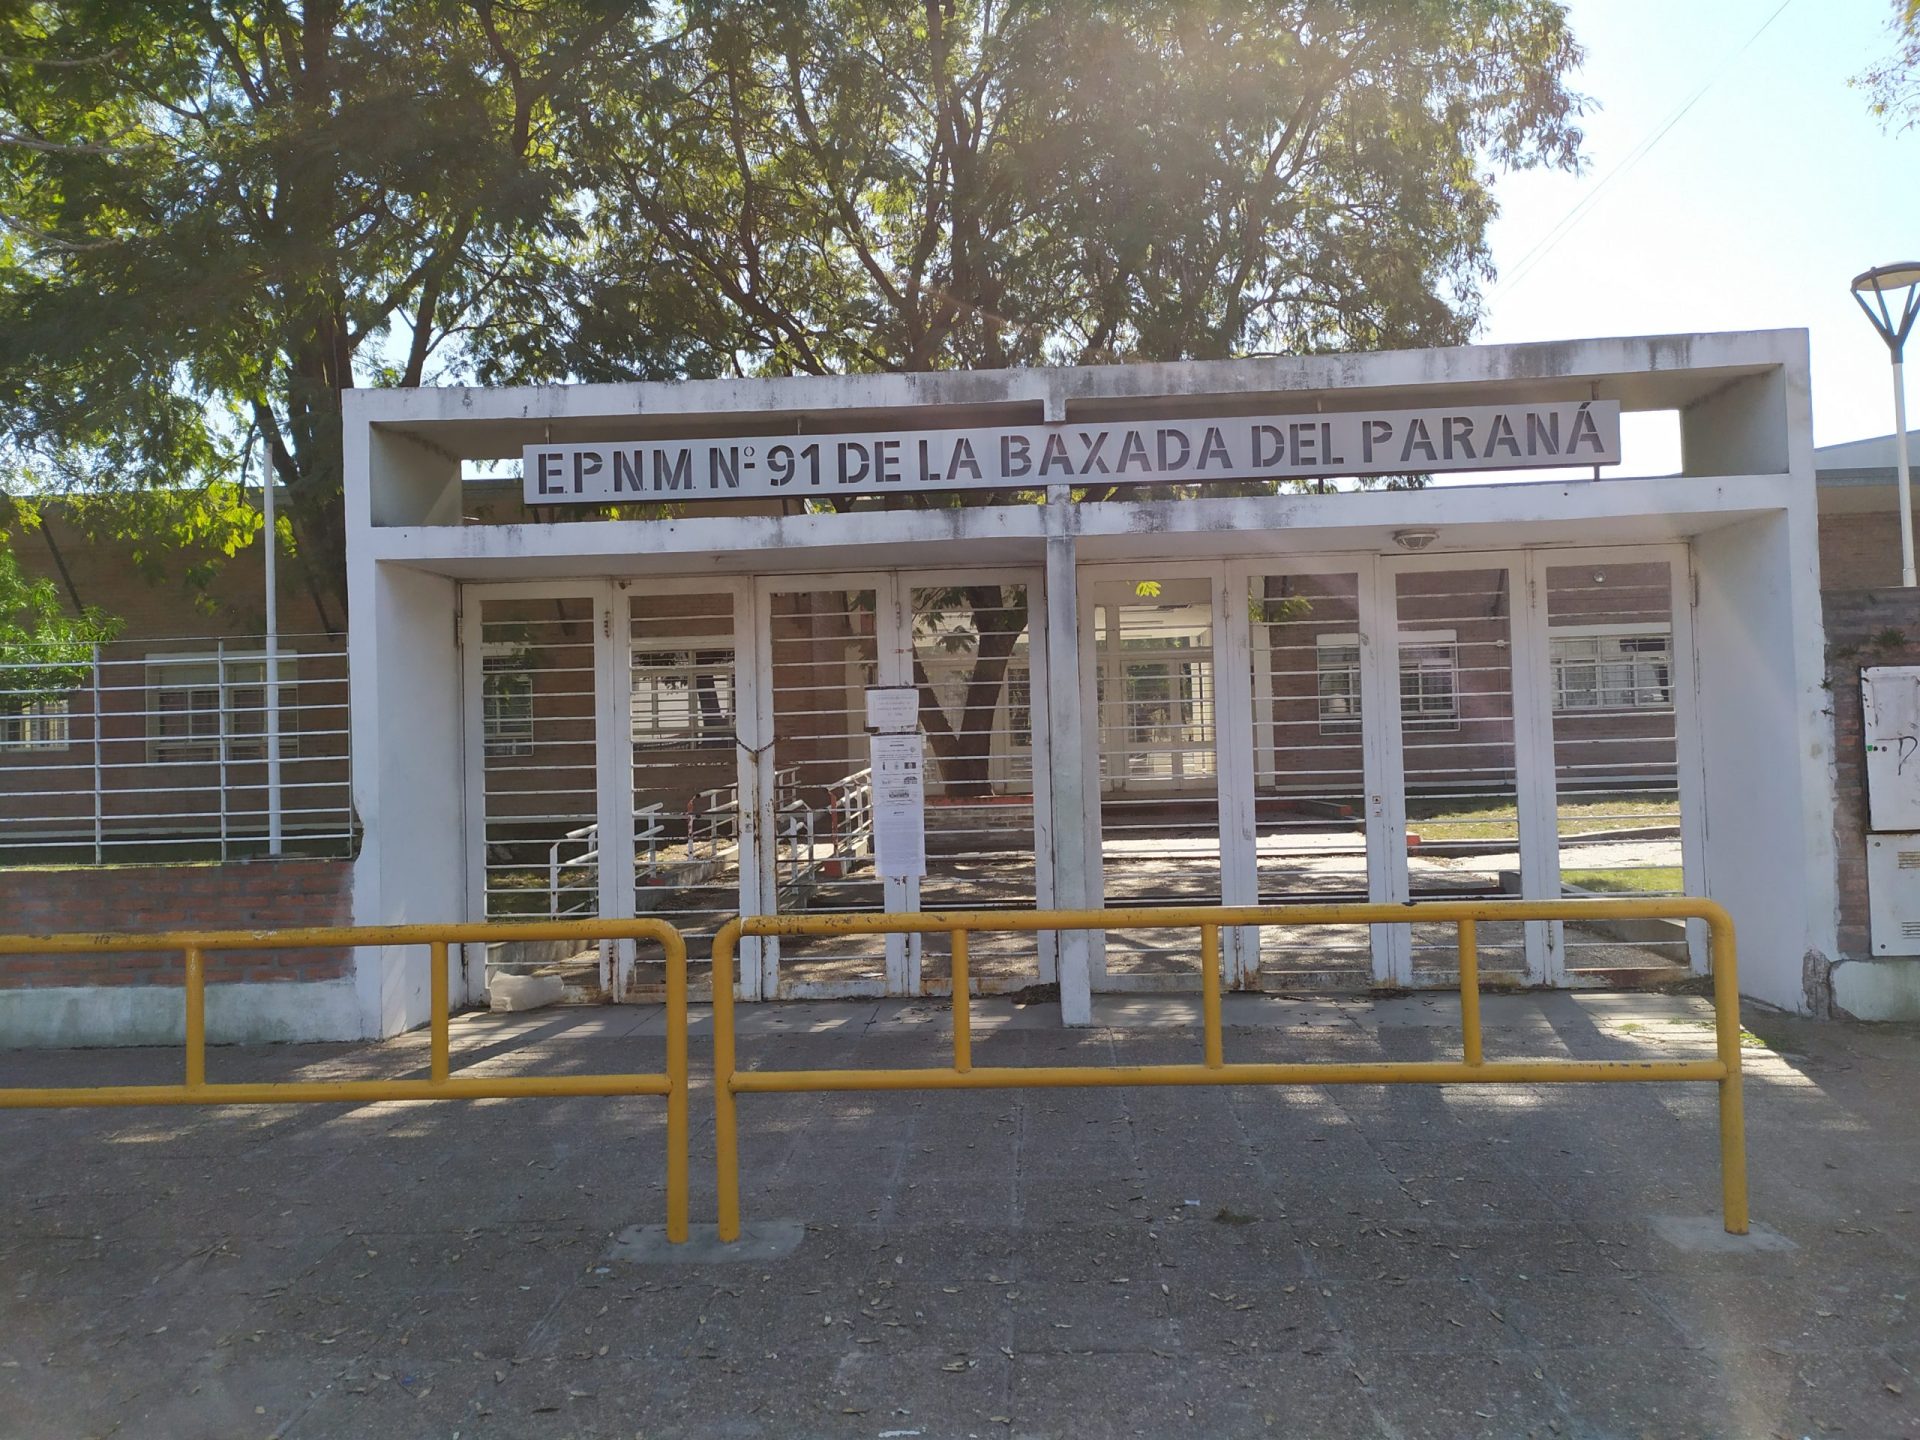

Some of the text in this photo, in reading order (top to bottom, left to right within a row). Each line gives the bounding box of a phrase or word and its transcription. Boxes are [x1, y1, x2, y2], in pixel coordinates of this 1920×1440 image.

[767, 444, 820, 487] 91
[838, 440, 901, 484] DE
[918, 437, 983, 481] LA
[1001, 427, 1233, 477] BAXADA
[1251, 421, 1345, 468] DEL
[1362, 402, 1606, 463] PARANÁ
